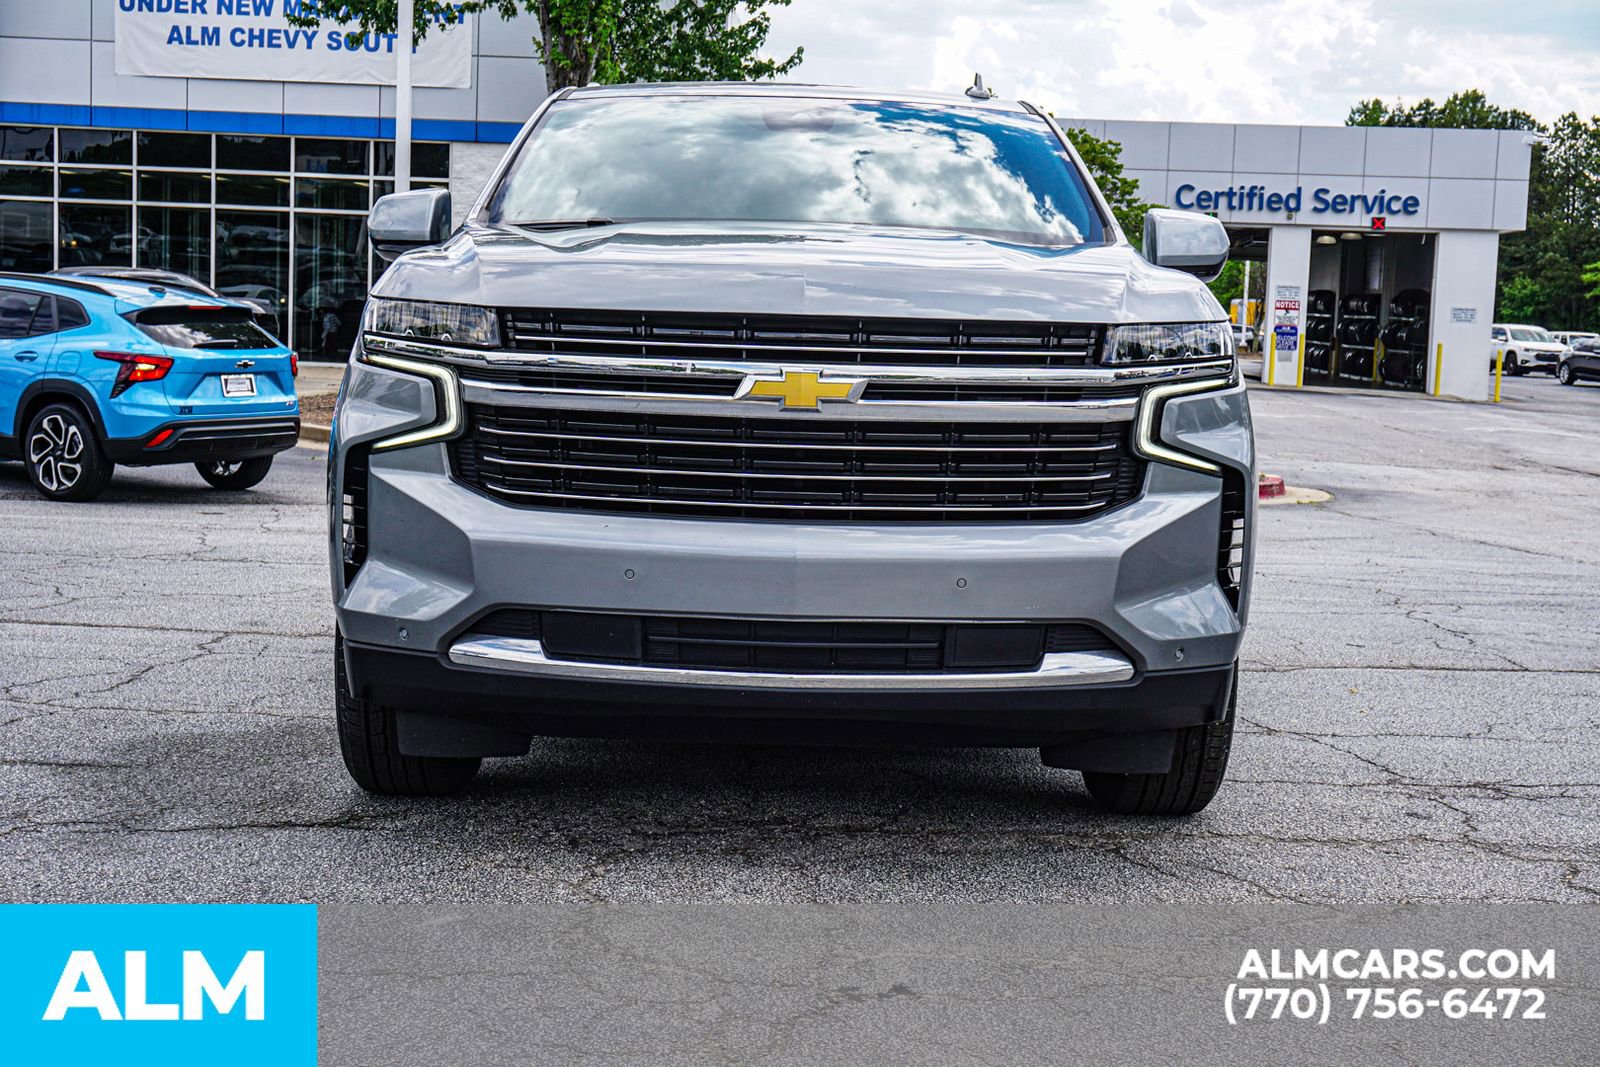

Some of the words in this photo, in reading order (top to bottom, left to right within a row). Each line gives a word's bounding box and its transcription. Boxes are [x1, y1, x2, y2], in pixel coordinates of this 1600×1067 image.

[119, 0, 208, 15] UNDER
[217, 0, 274, 17] NEW
[166, 25, 221, 46] ALM
[229, 27, 318, 50] CHEVY
[326, 31, 417, 54] SOUT
[1175, 184, 1303, 212] Certified
[1312, 188, 1421, 215] Service
[1275, 301, 1300, 309] NOTICE
